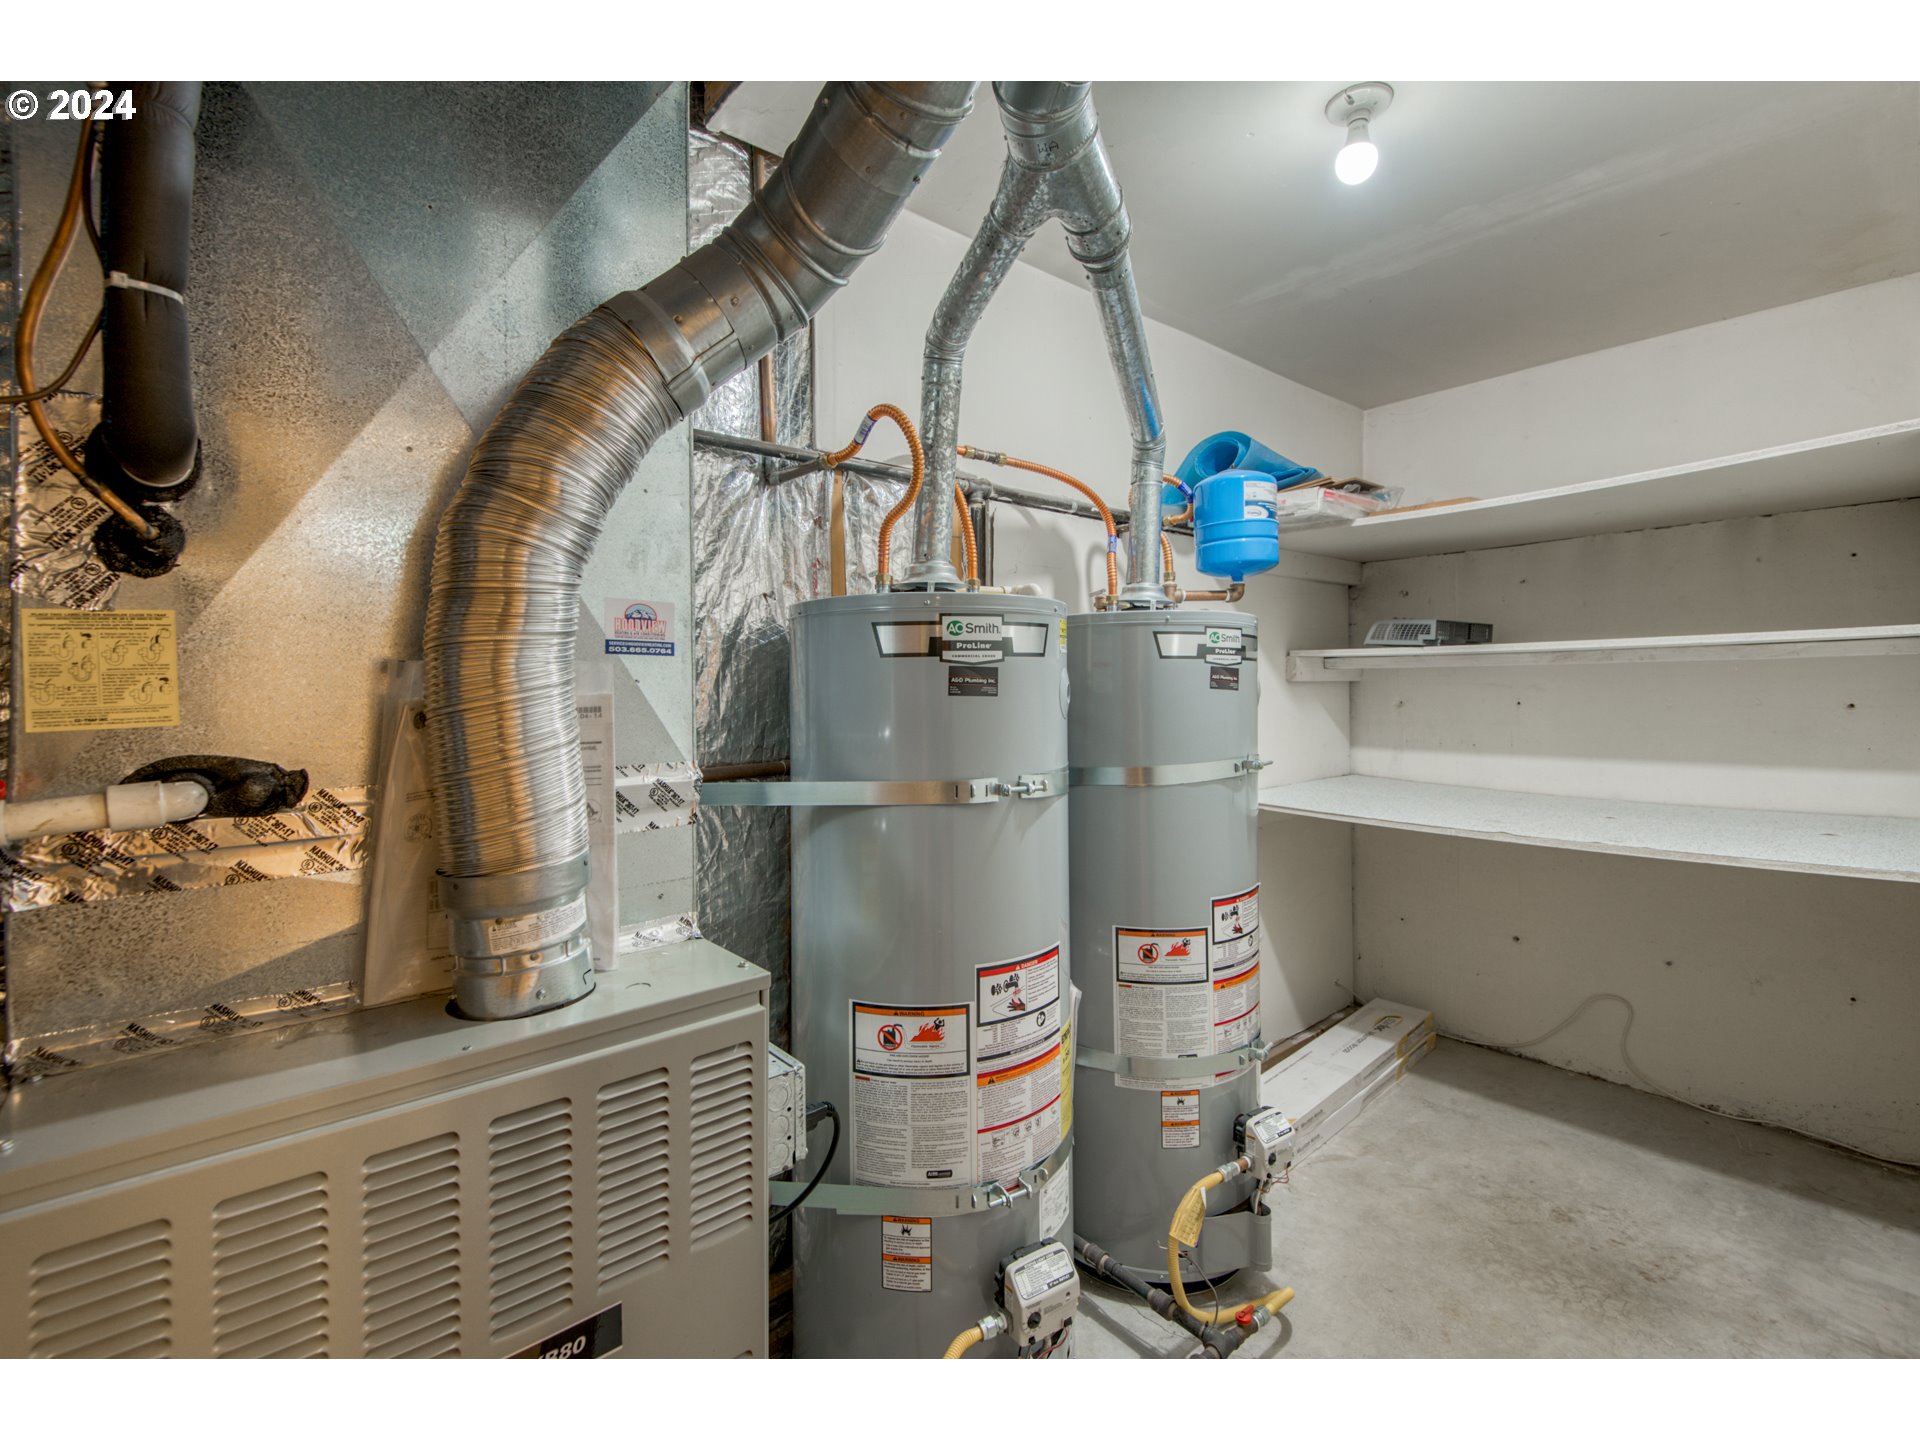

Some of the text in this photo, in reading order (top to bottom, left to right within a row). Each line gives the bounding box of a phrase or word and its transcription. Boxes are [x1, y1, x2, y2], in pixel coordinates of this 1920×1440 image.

[73, 505, 109, 531] NASHUA
[85, 571, 121, 598] NASHUA
[316, 788, 346, 808] NASHUA
[309, 845, 339, 867] NASHUA
[234, 859, 265, 882] NASHUA
[210, 1003, 243, 1023] NASHUA
